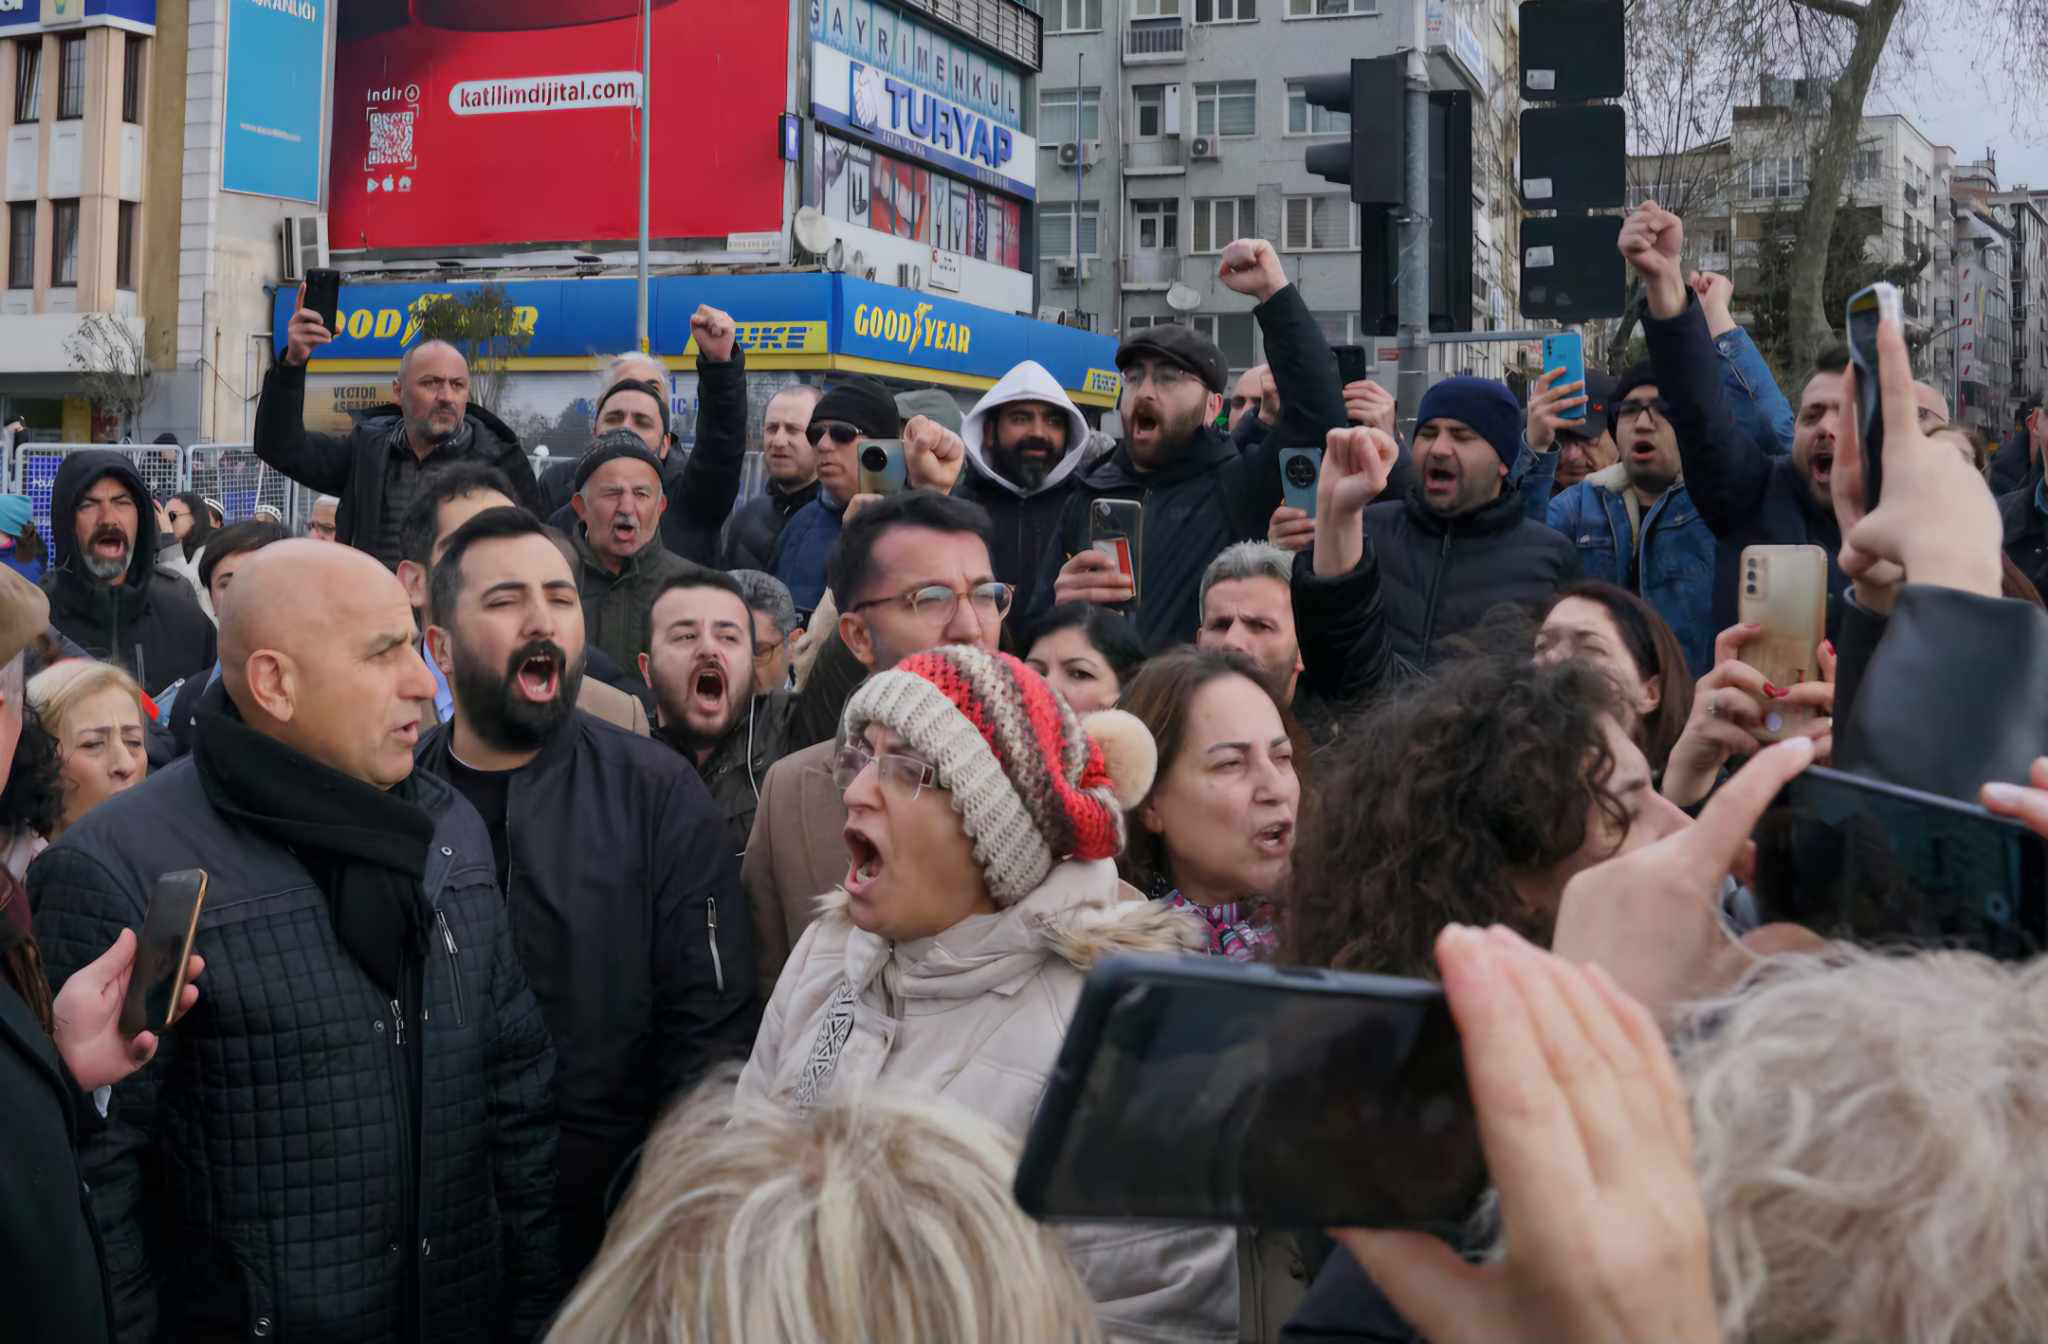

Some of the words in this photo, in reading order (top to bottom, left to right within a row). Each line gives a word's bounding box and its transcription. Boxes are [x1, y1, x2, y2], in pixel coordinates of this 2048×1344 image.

[885, 77, 1013, 169] TURYAP
[736, 327, 807, 349] UKE
[333, 386, 377, 399] VECTOR
